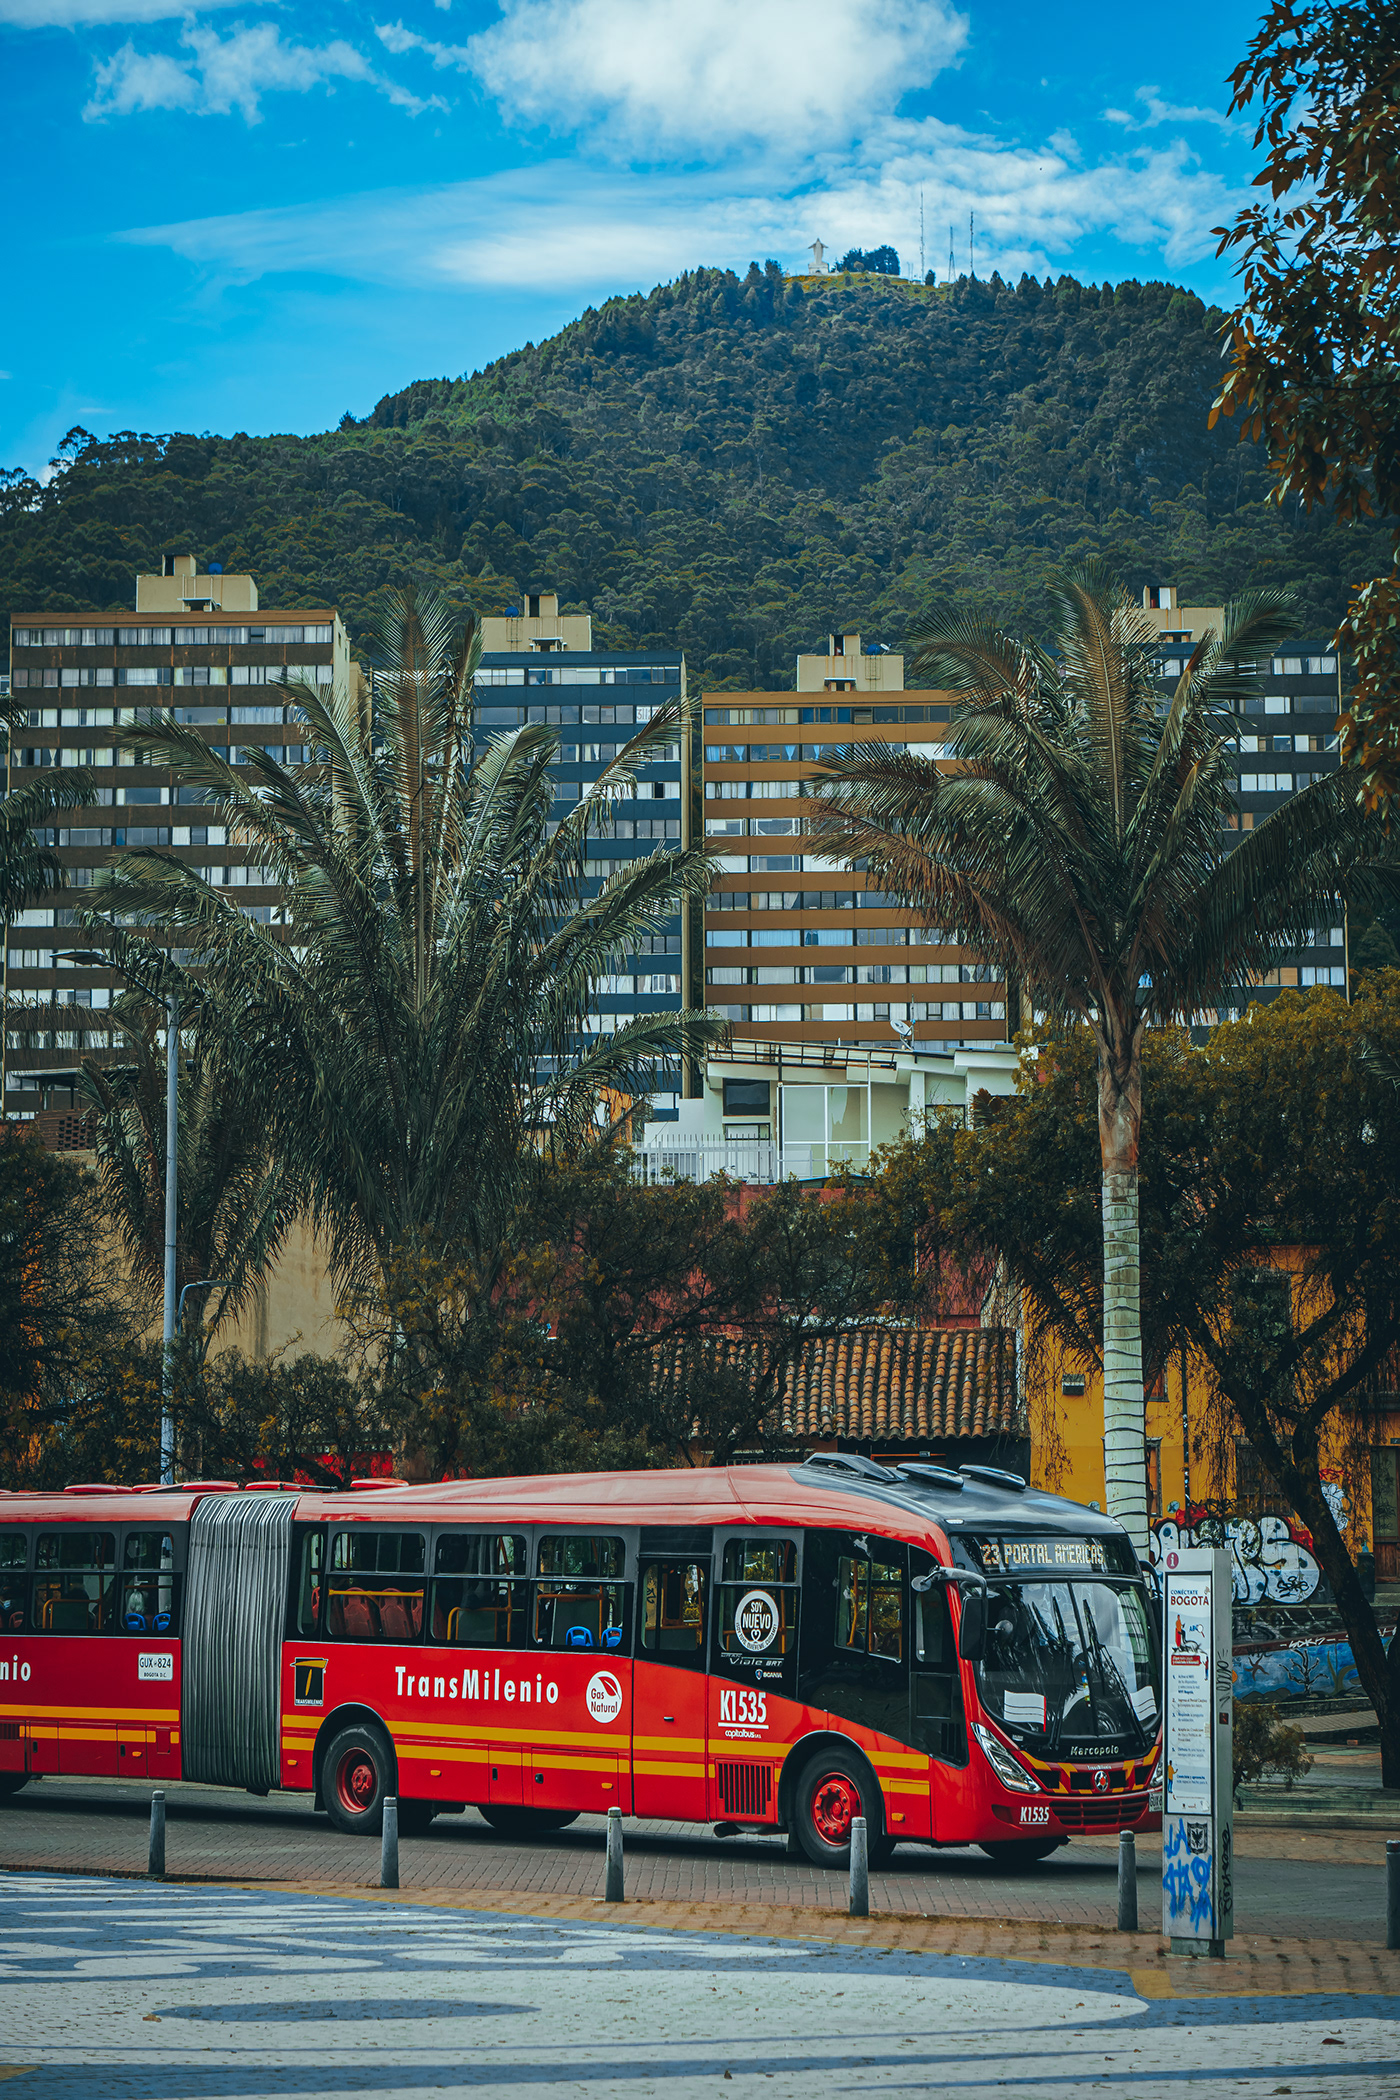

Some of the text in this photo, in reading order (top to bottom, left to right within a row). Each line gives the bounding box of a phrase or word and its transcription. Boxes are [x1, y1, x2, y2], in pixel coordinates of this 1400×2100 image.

[982, 1543, 1104, 1565] 23 PORTAL AMERICAS
[750, 1602, 764, 1613] SOY
[742, 1613, 771, 1629] NUEVO
[0, 1654, 31, 1682] nio
[729, 1657, 783, 1668] Viale BRT
[762, 1671, 783, 1679] SCANIA
[395, 1666, 559, 1704] TransMilenio
[591, 1688, 605, 1700] Gas
[590, 1701, 618, 1714] Natural
[720, 1690, 767, 1723] K1535
[1070, 1745, 1120, 1756] Marcopolo
[1020, 1806, 1050, 1822] K1535
